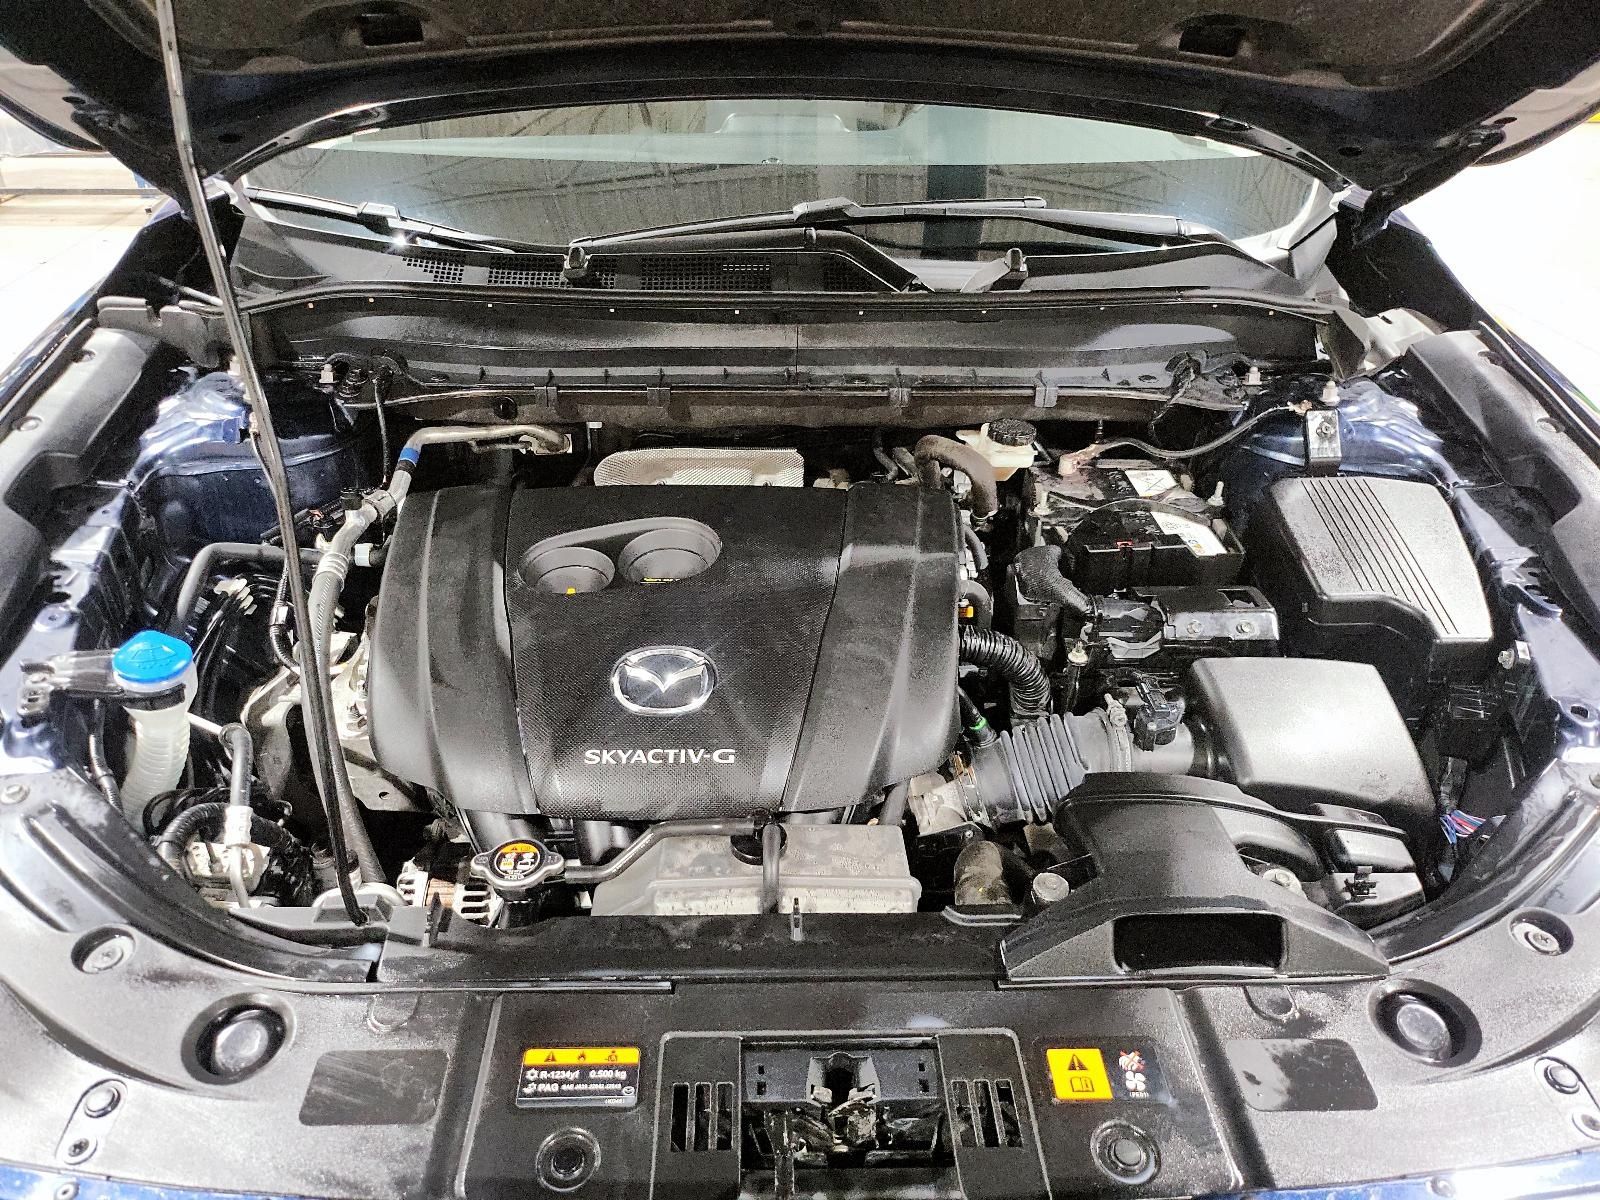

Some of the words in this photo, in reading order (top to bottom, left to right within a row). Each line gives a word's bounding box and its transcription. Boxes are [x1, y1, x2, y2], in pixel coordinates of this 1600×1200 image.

[584, 748, 736, 765] SKYACTIV-G
[540, 1070, 580, 1081] R-1234yf
[589, 1069, 614, 1079] 0.500
[615, 1070, 628, 1081] kg
[537, 1082, 559, 1093] PAG
